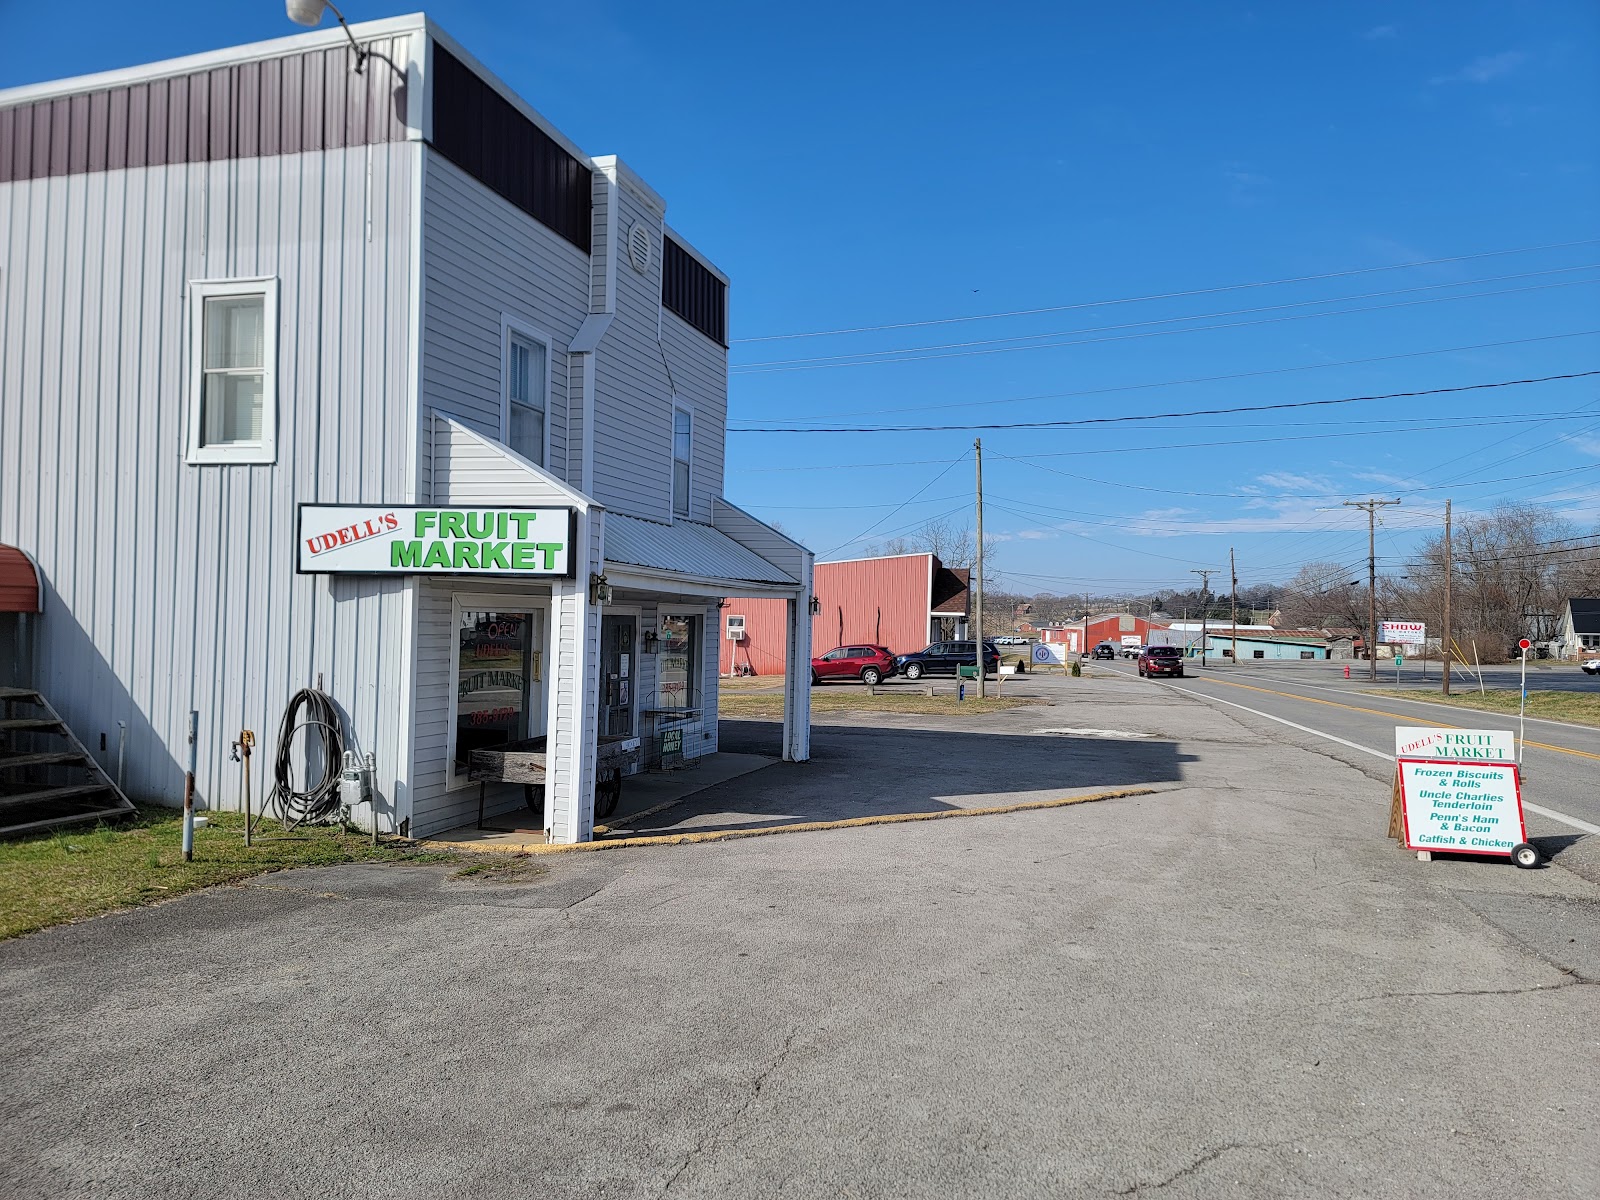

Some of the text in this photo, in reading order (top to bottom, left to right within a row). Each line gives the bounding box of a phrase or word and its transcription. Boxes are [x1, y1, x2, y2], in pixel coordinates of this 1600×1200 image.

[415, 511, 536, 539] FRUIT
[306, 512, 399, 554] UDELL'S
[390, 541, 563, 569] MARKET
[488, 623, 518, 639] OPEN
[664, 730, 681, 742] LOCAL
[1445, 734, 1494, 746] FRUIT
[663, 740, 682, 753] HONEY
[1401, 733, 1443, 754] UDELL'S
[1434, 746, 1506, 759] MARKET
[1414, 768, 1504, 780] Frozen Biscuits
[1438, 779, 1482, 789] & Rolls
[1419, 790, 1504, 802] Uncle Charlies
[1432, 800, 1493, 811] Tenderloin
[1430, 812, 1500, 825] Penn's Ham
[1440, 822, 1491, 833] & Bacon
[1418, 834, 1514, 848] Catfish & Chicken
